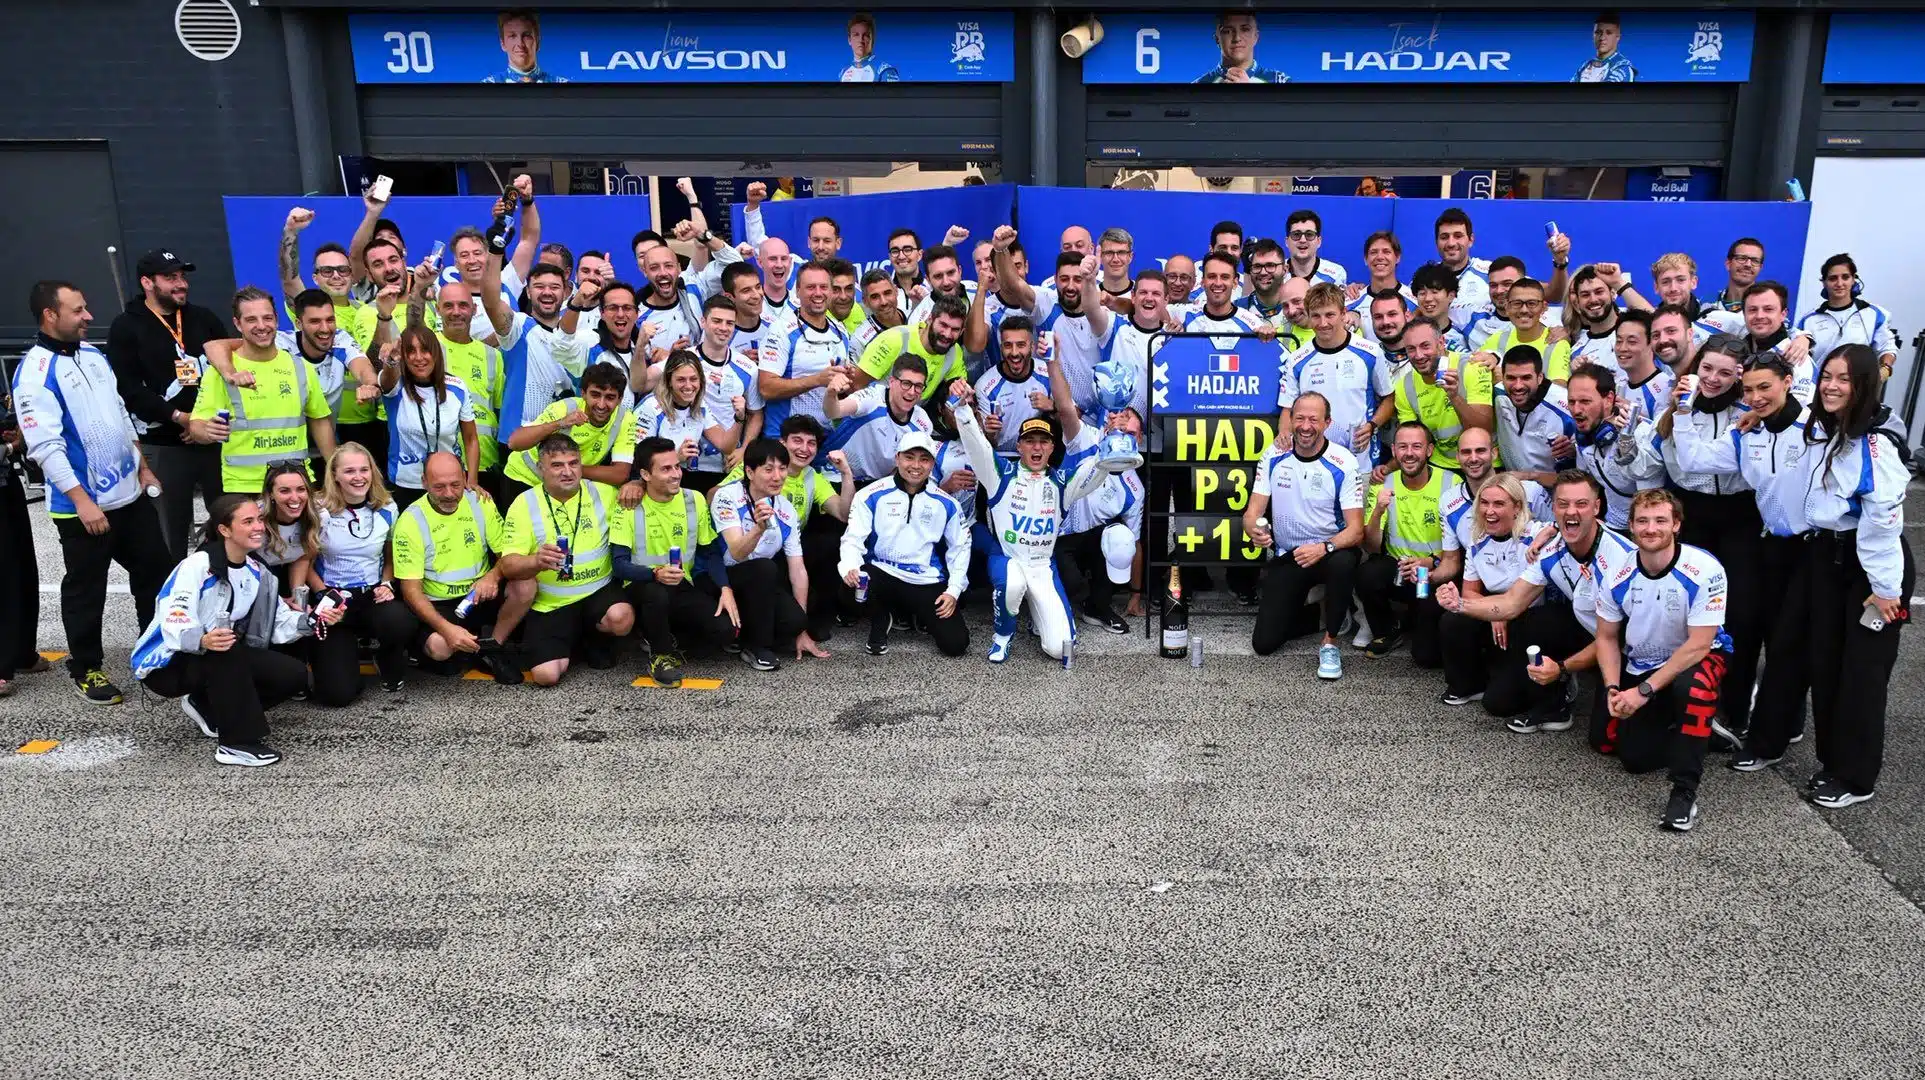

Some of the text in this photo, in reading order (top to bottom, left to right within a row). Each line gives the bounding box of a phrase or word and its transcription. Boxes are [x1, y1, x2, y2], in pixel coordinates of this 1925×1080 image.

[957, 21, 980, 31] VISA
[1697, 21, 1720, 31] VISA
[662, 20, 699, 57] Liam
[1384, 15, 1440, 55] Isack
[383, 31, 434, 73] 30
[1134, 28, 1160, 74] 6
[579, 50, 787, 70] LAWSON
[1321, 51, 1511, 71] HADJAR
[1651, 182, 1689, 192] Red Bull
[1241, 313, 1256, 326] HUGO
[1356, 341, 1374, 351] HUGO
[273, 369, 293, 377] HUGO
[983, 378, 996, 393] HUGO
[1187, 375, 1260, 395] HADJAR
[916, 418, 929, 432] HUGO
[253, 435, 298, 449] Airtasker
[1176, 418, 1275, 461] HAD
[1329, 453, 1345, 465] HUGO
[1126, 476, 1138, 493] HUGO
[1195, 469, 1249, 511] P 3
[1422, 495, 1438, 503] HUGO
[1446, 496, 1465, 510] HUGO
[1010, 502, 1026, 511] Mobil
[670, 511, 686, 519] HUGO
[777, 508, 790, 521] HUGO
[1423, 512, 1436, 521] RB
[1009, 511, 1055, 536] VISA
[1019, 537, 1040, 547] Cash
[165, 616, 191, 625] Red Bull
